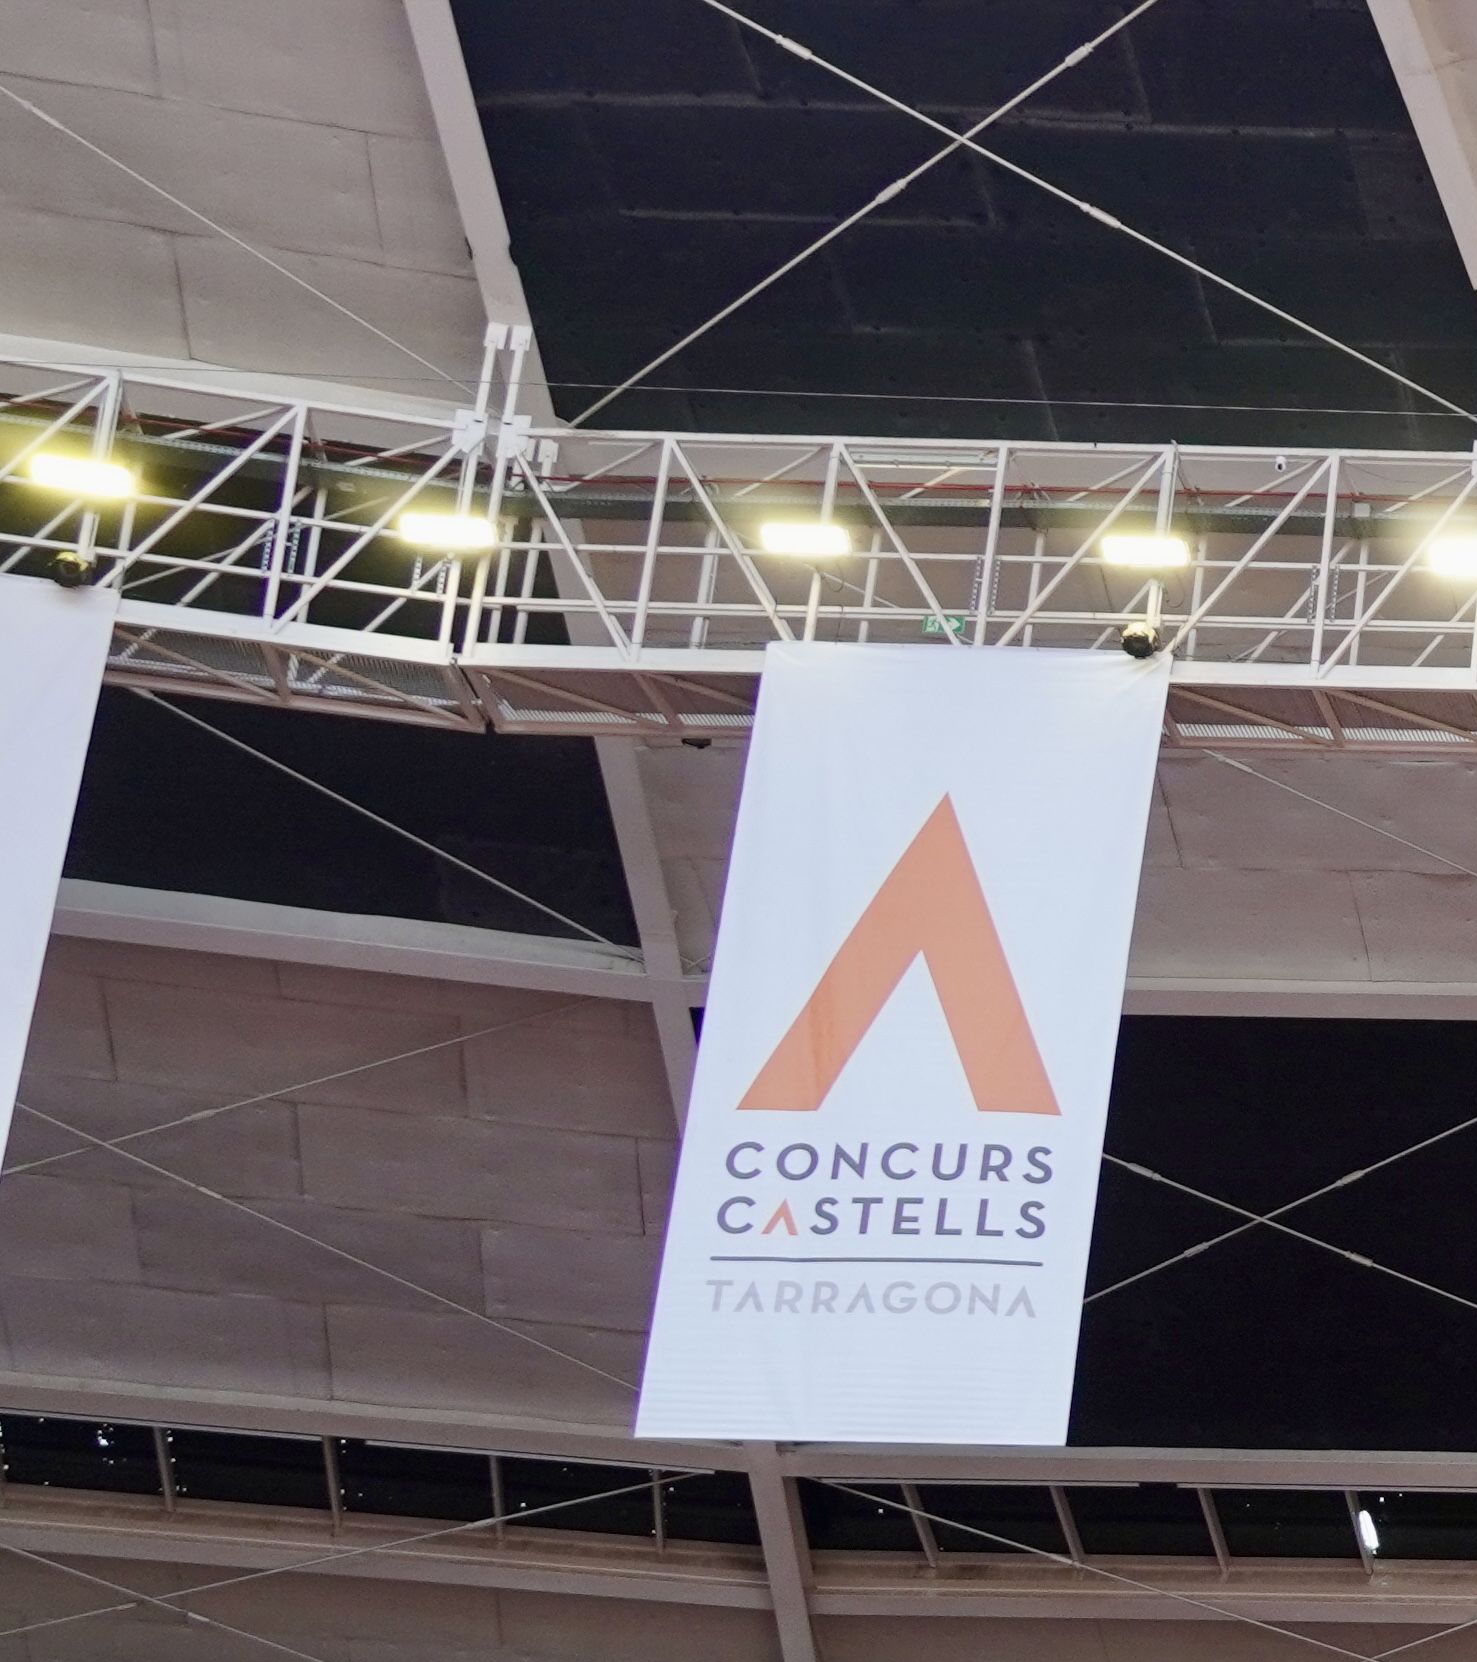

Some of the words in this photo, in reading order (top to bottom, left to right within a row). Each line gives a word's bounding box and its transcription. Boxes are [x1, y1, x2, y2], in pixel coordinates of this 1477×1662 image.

[724, 1140, 1054, 1186] CONCURS
[715, 1195, 1048, 1242] CASTELLS
[705, 1276, 1038, 1319] TARRAGONA
